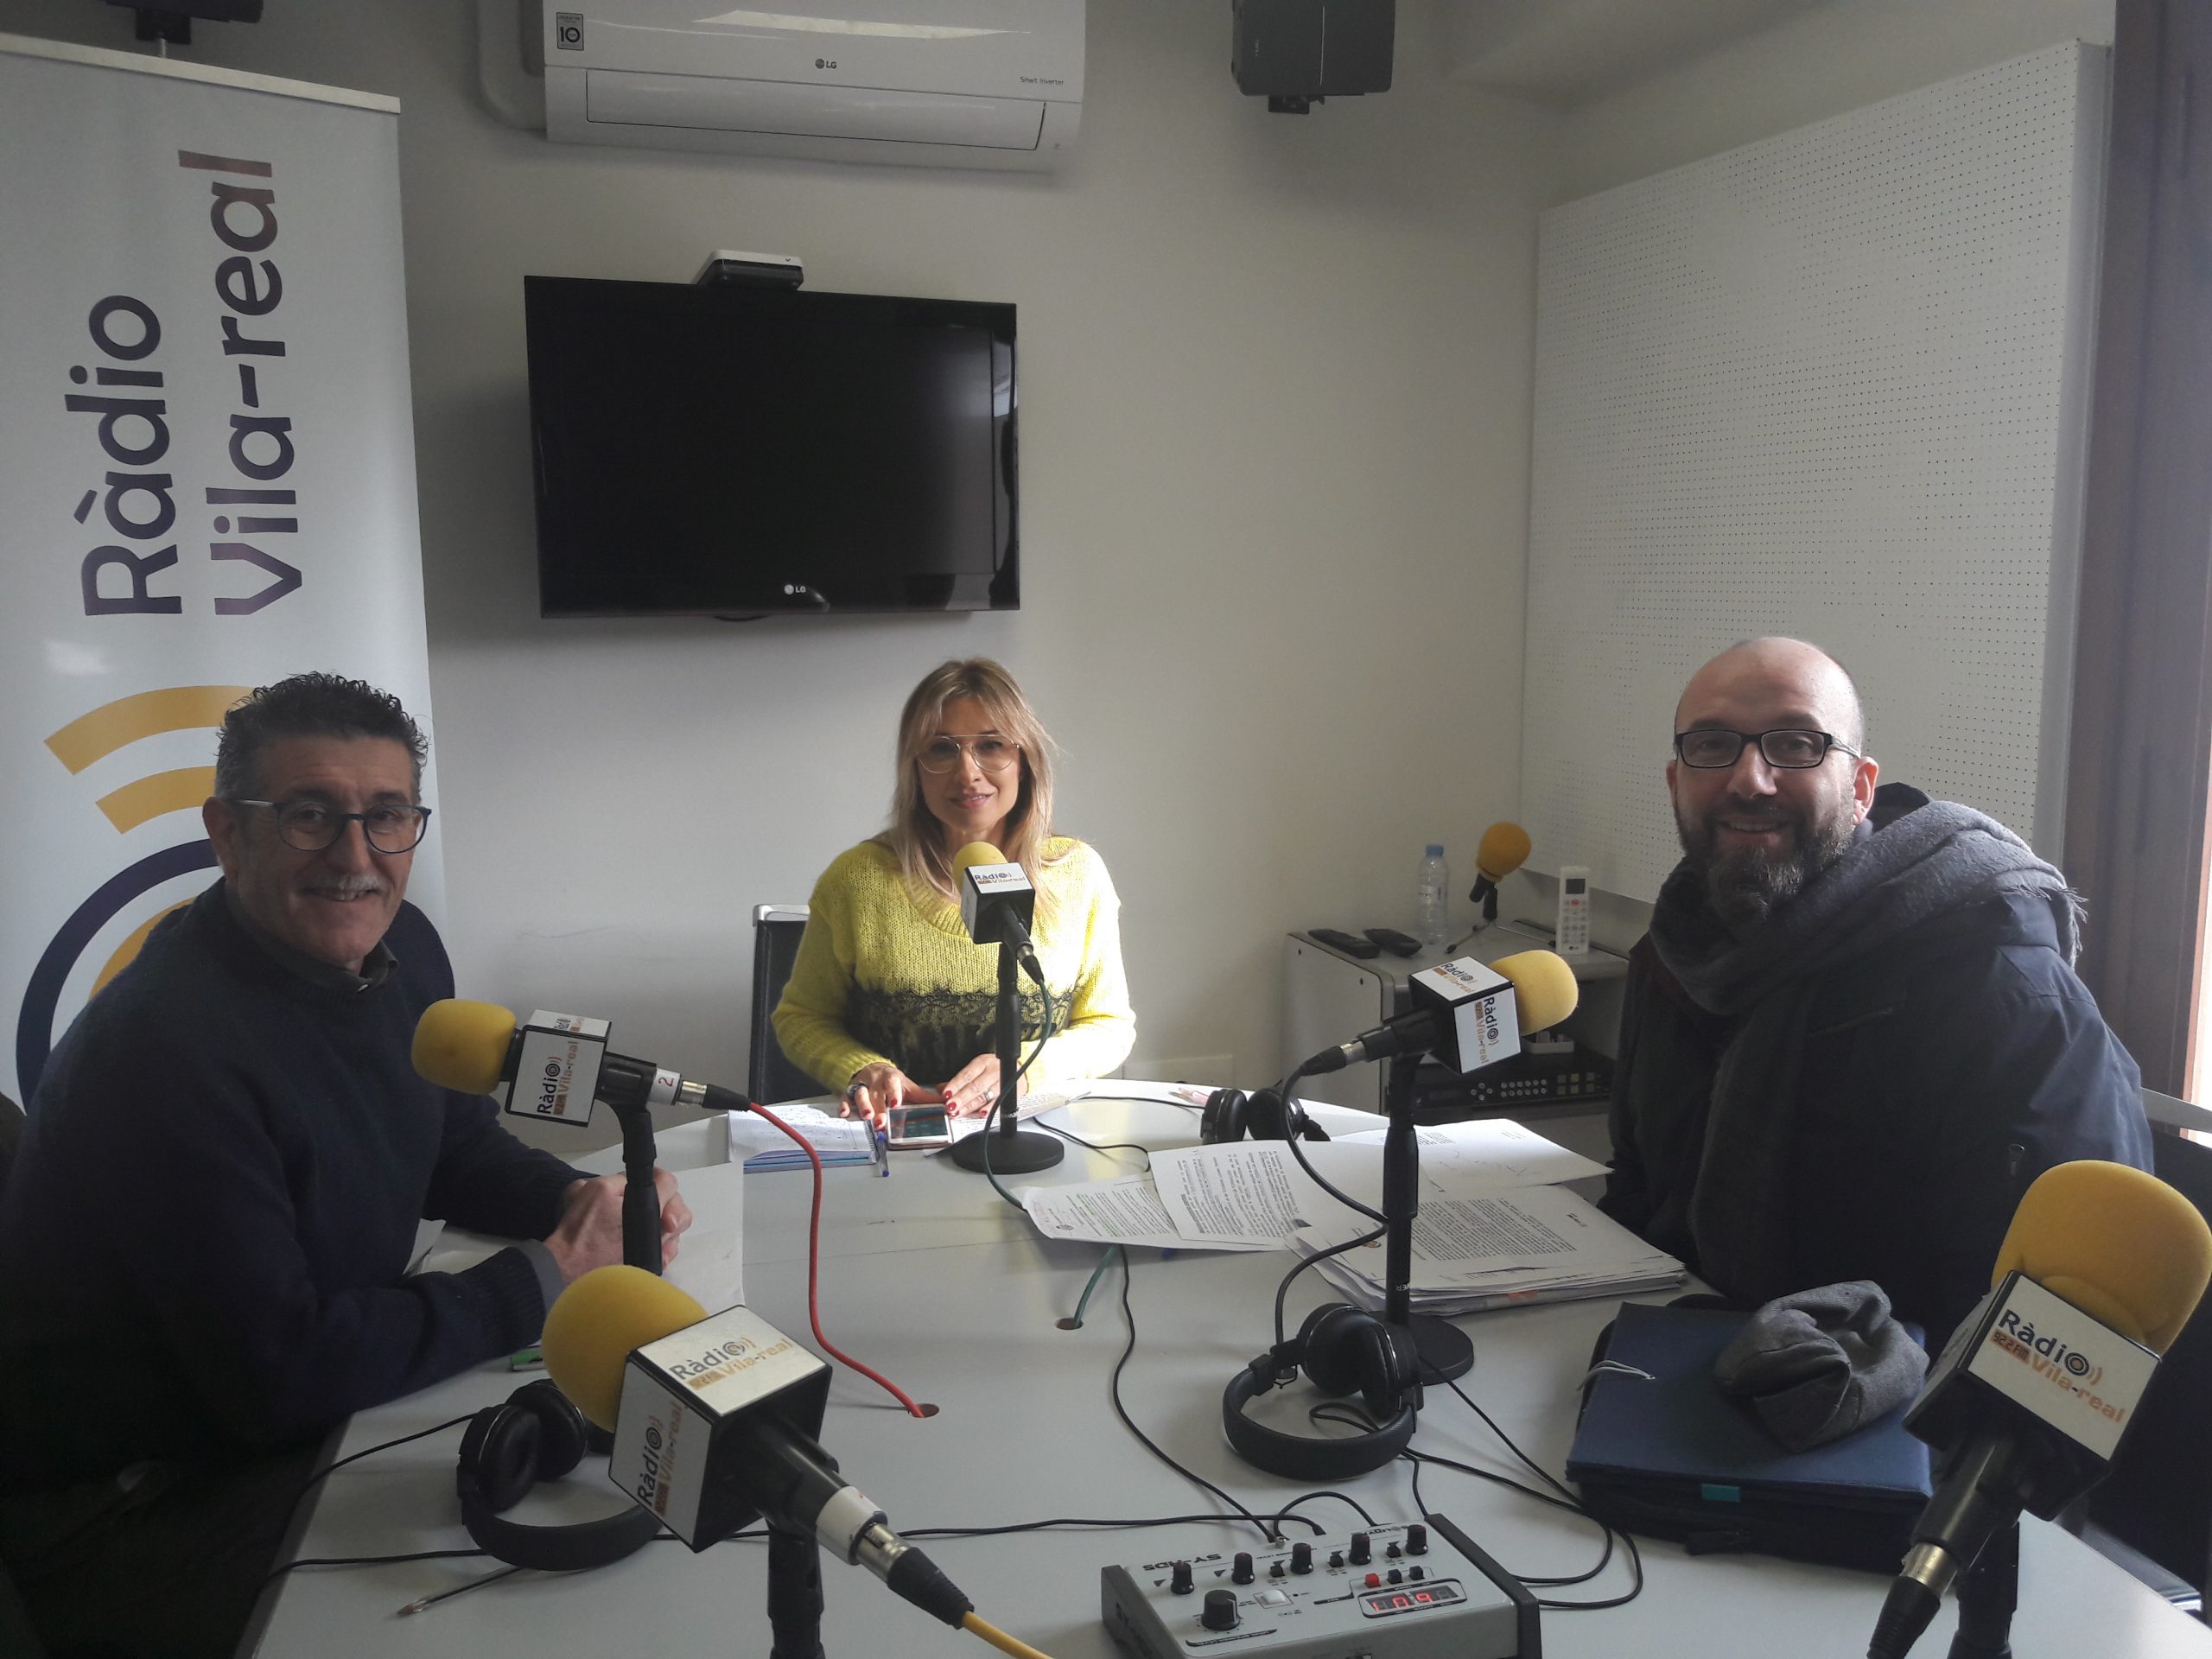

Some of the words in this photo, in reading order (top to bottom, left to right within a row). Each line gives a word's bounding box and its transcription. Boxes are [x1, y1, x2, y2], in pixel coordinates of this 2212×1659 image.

[65, 295, 182, 616] Ràdio
[178, 149, 302, 615] Vila-real
[721, 1338, 793, 1376] Vila-real
[2031, 1354, 2126, 1422] Vila-real
